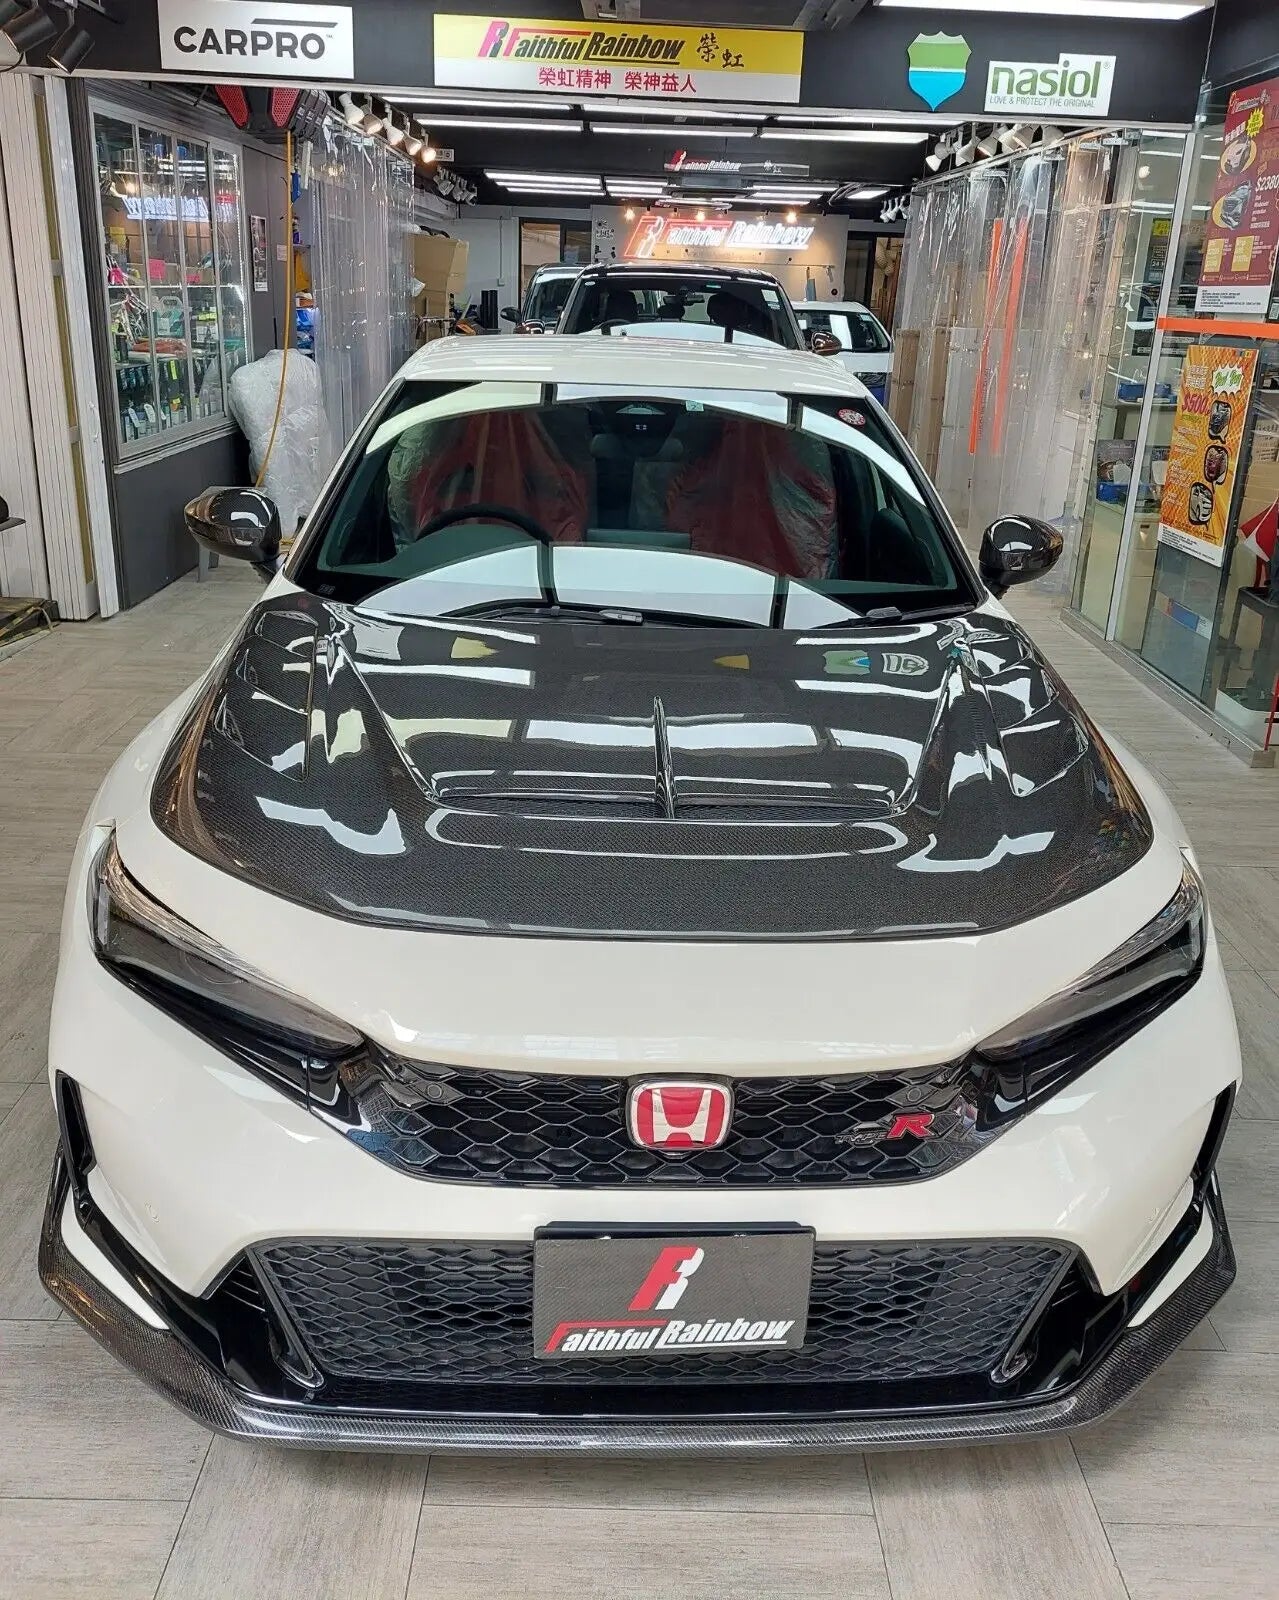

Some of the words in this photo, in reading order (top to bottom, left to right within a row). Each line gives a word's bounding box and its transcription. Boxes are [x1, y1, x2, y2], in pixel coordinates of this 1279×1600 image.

[174, 26, 326, 60] CARPRO
[502, 28, 591, 61] Faithful
[582, 31, 686, 65] Rainbow
[538, 67, 612, 90] 榮虹精神
[624, 70, 697, 93] 榮神益人
[991, 60, 1102, 99] nasiol
[989, 96, 1007, 105] LOVE
[1008, 97, 1014, 105] &
[1015, 97, 1048, 106] PROTECT
[1049, 98, 1062, 107] THE
[1063, 98, 1096, 108] ORIGINAL
[886, 1113, 937, 1140] R
[544, 1319, 668, 1354] Faithful
[654, 1318, 796, 1349] Rainbow
